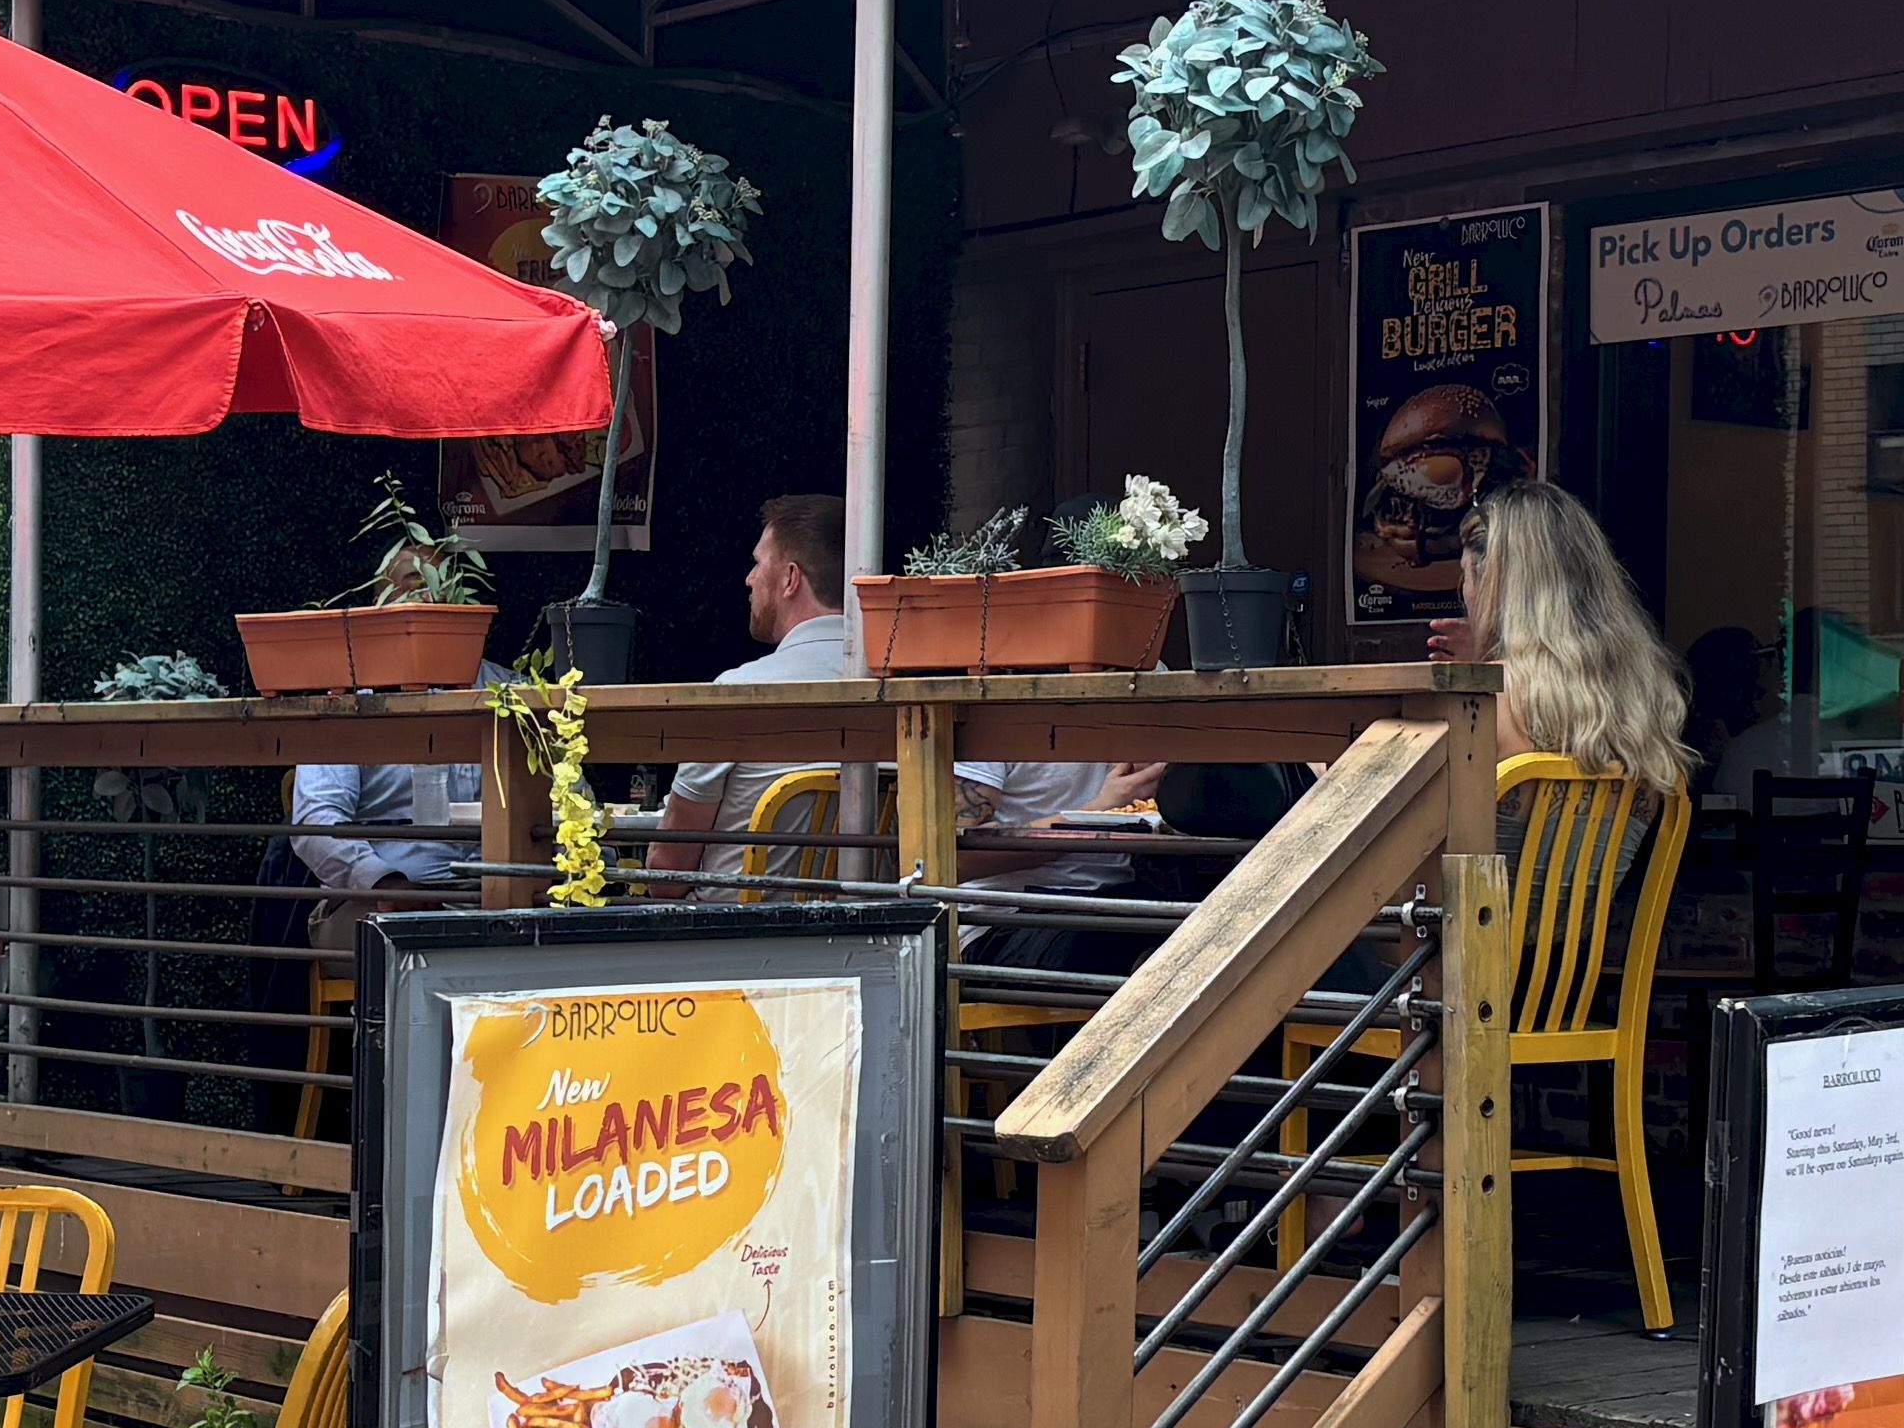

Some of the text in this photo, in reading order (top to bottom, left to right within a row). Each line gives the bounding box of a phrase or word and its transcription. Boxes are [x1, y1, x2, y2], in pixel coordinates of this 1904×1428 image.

[126, 80, 315, 151] OPEN
[176, 210, 393, 280] Coca-Cola
[1403, 250, 1435, 266] New
[1599, 214, 1836, 268] Pick Up Orders
[1408, 260, 1487, 302] GRILL
[1635, 278, 1722, 323] Palmas
[1781, 272, 1887, 311] BARROLUCO
[1412, 293, 1474, 315] Delicious
[1382, 305, 1517, 359] BURGER
[552, 997, 696, 1041] BARROLUCO
[537, 1067, 610, 1112] New
[502, 1074, 779, 1186] MILANESA
[546, 1150, 730, 1232] LOADED
[740, 1243, 789, 1265] Delicious
[751, 1260, 781, 1278] Taste
